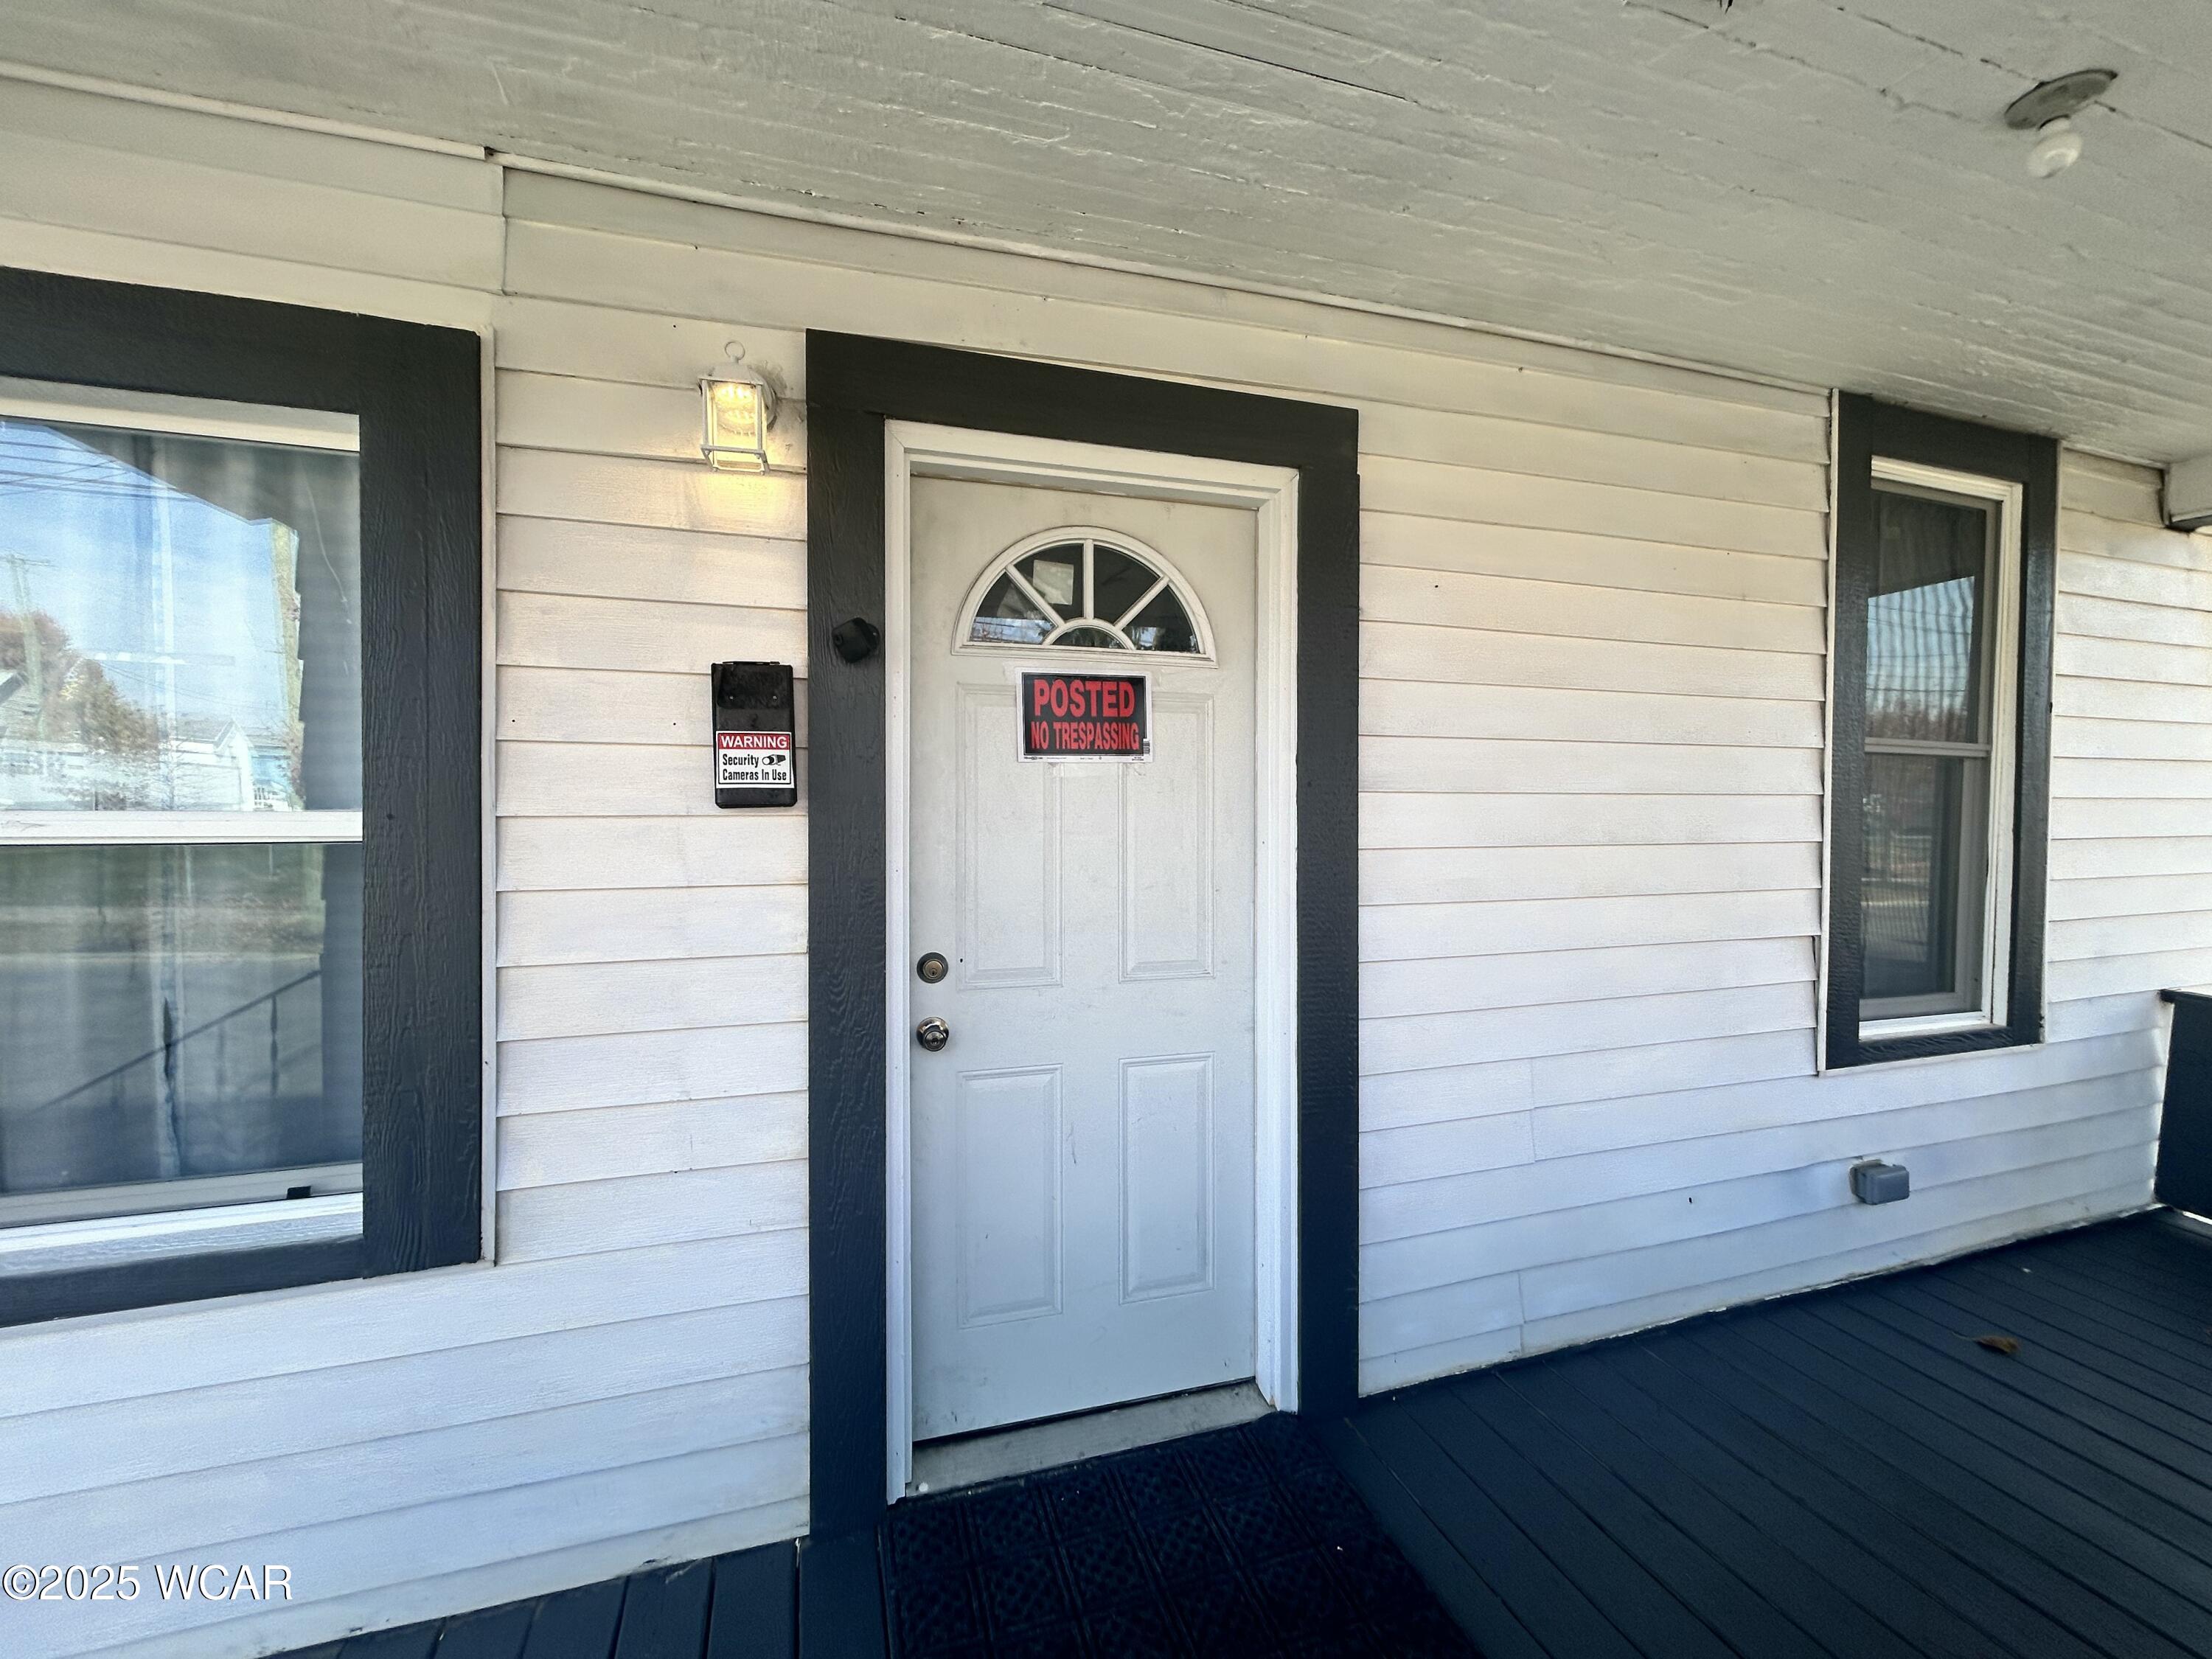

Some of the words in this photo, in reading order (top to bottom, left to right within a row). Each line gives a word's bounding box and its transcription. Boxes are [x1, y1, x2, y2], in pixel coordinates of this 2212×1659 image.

[1034, 679, 1135, 717] POSTED
[720, 735, 787, 748] WARNING
[1031, 721, 1049, 750] NO
[1053, 721, 1140, 751] TRESPASSING
[723, 754, 759, 768] Security
[723, 768, 759, 781] Cameras
[762, 769, 769, 781] In
[772, 769, 787, 781] Use
